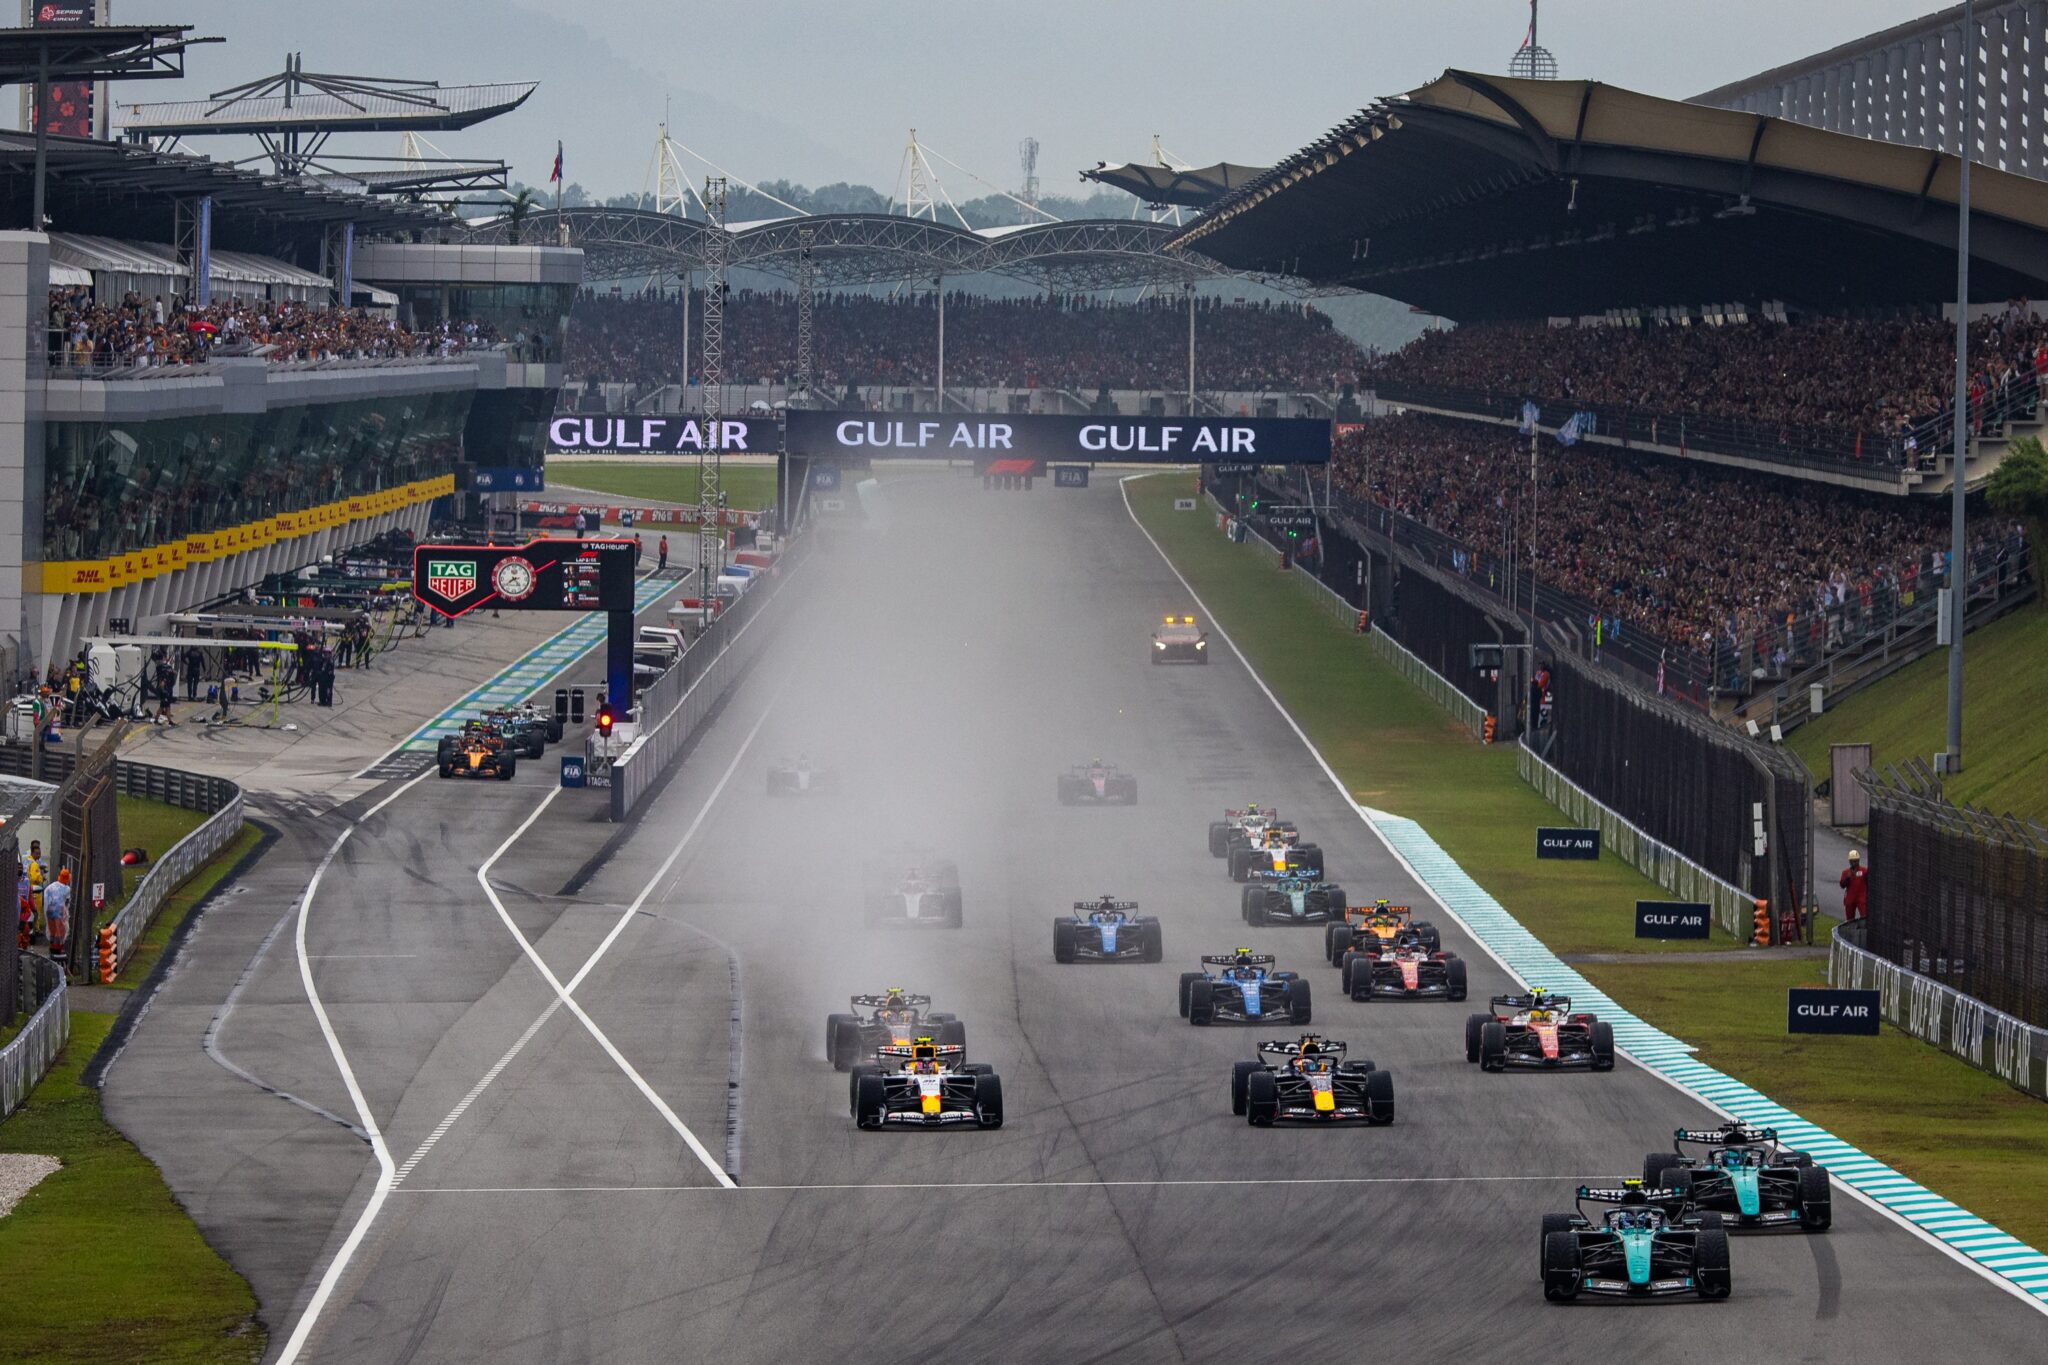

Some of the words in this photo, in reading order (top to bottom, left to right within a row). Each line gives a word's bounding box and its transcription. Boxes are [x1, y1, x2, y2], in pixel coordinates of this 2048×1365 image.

[549, 417, 667, 448] GULF
[675, 420, 749, 450] AIR
[836, 420, 940, 448] GULF
[949, 422, 1014, 449] AIR
[1078, 424, 1184, 452] GULF
[1191, 426, 1257, 454] AIR
[1218, 465, 1239, 473] GULF
[1063, 471, 1082, 482] FIA
[1270, 517, 1294, 525] GULF
[1296, 517, 1312, 525] AIR
[75, 570, 101, 584] DHL
[432, 563, 472, 577] TAG
[431, 578, 473, 598] HEUER
[563, 767, 581, 777] FIA
[1543, 838, 1571, 848] GULF
[1574, 839, 1593, 849] AIR
[1643, 914, 1679, 925] GULF
[1680, 915, 1703, 926] AIR
[1797, 1004, 1840, 1017] GULF
[1841, 1005, 1870, 1018] AIR
[1909, 975, 1932, 1038] GULF
[1927, 983, 1943, 1046] AIR
[1952, 993, 1974, 1059] GULF
[1969, 1001, 1985, 1067] AIR
[1995, 1014, 2019, 1081] GULF
[2015, 1022, 2031, 1090] AIR
